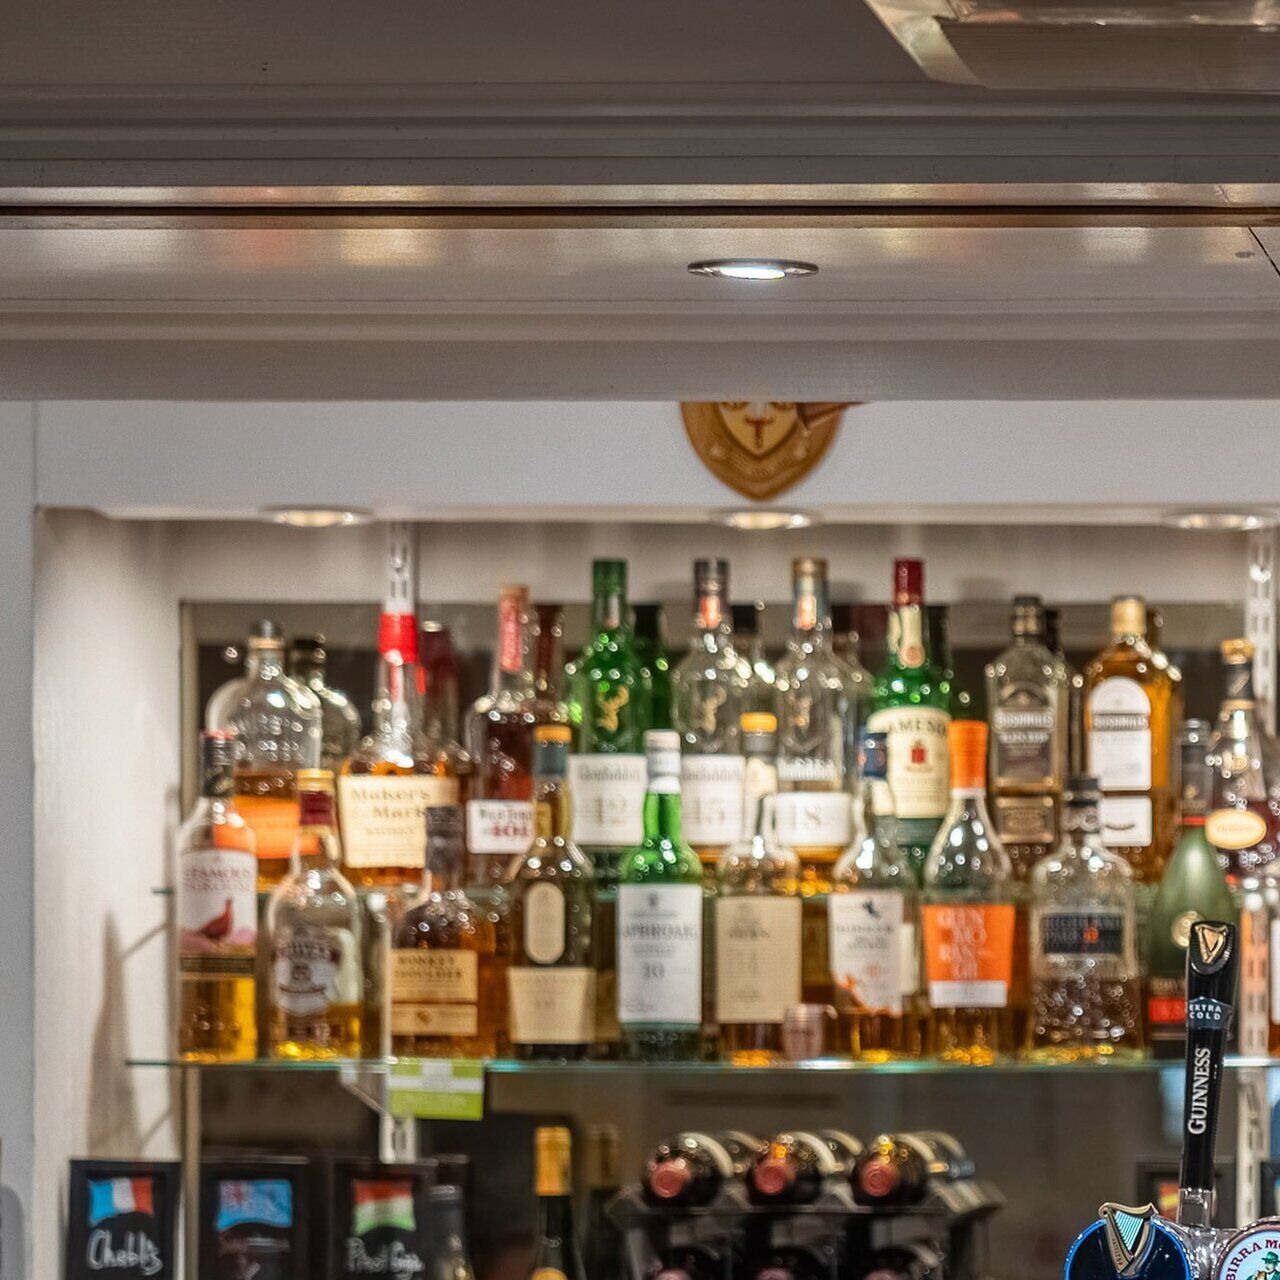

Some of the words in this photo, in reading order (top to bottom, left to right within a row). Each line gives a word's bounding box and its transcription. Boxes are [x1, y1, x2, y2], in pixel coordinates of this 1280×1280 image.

[1189, 1004, 1222, 1013] EXTRA
[1189, 1012, 1221, 1021] COLD
[1187, 1047, 1212, 1135] GUINNESS
